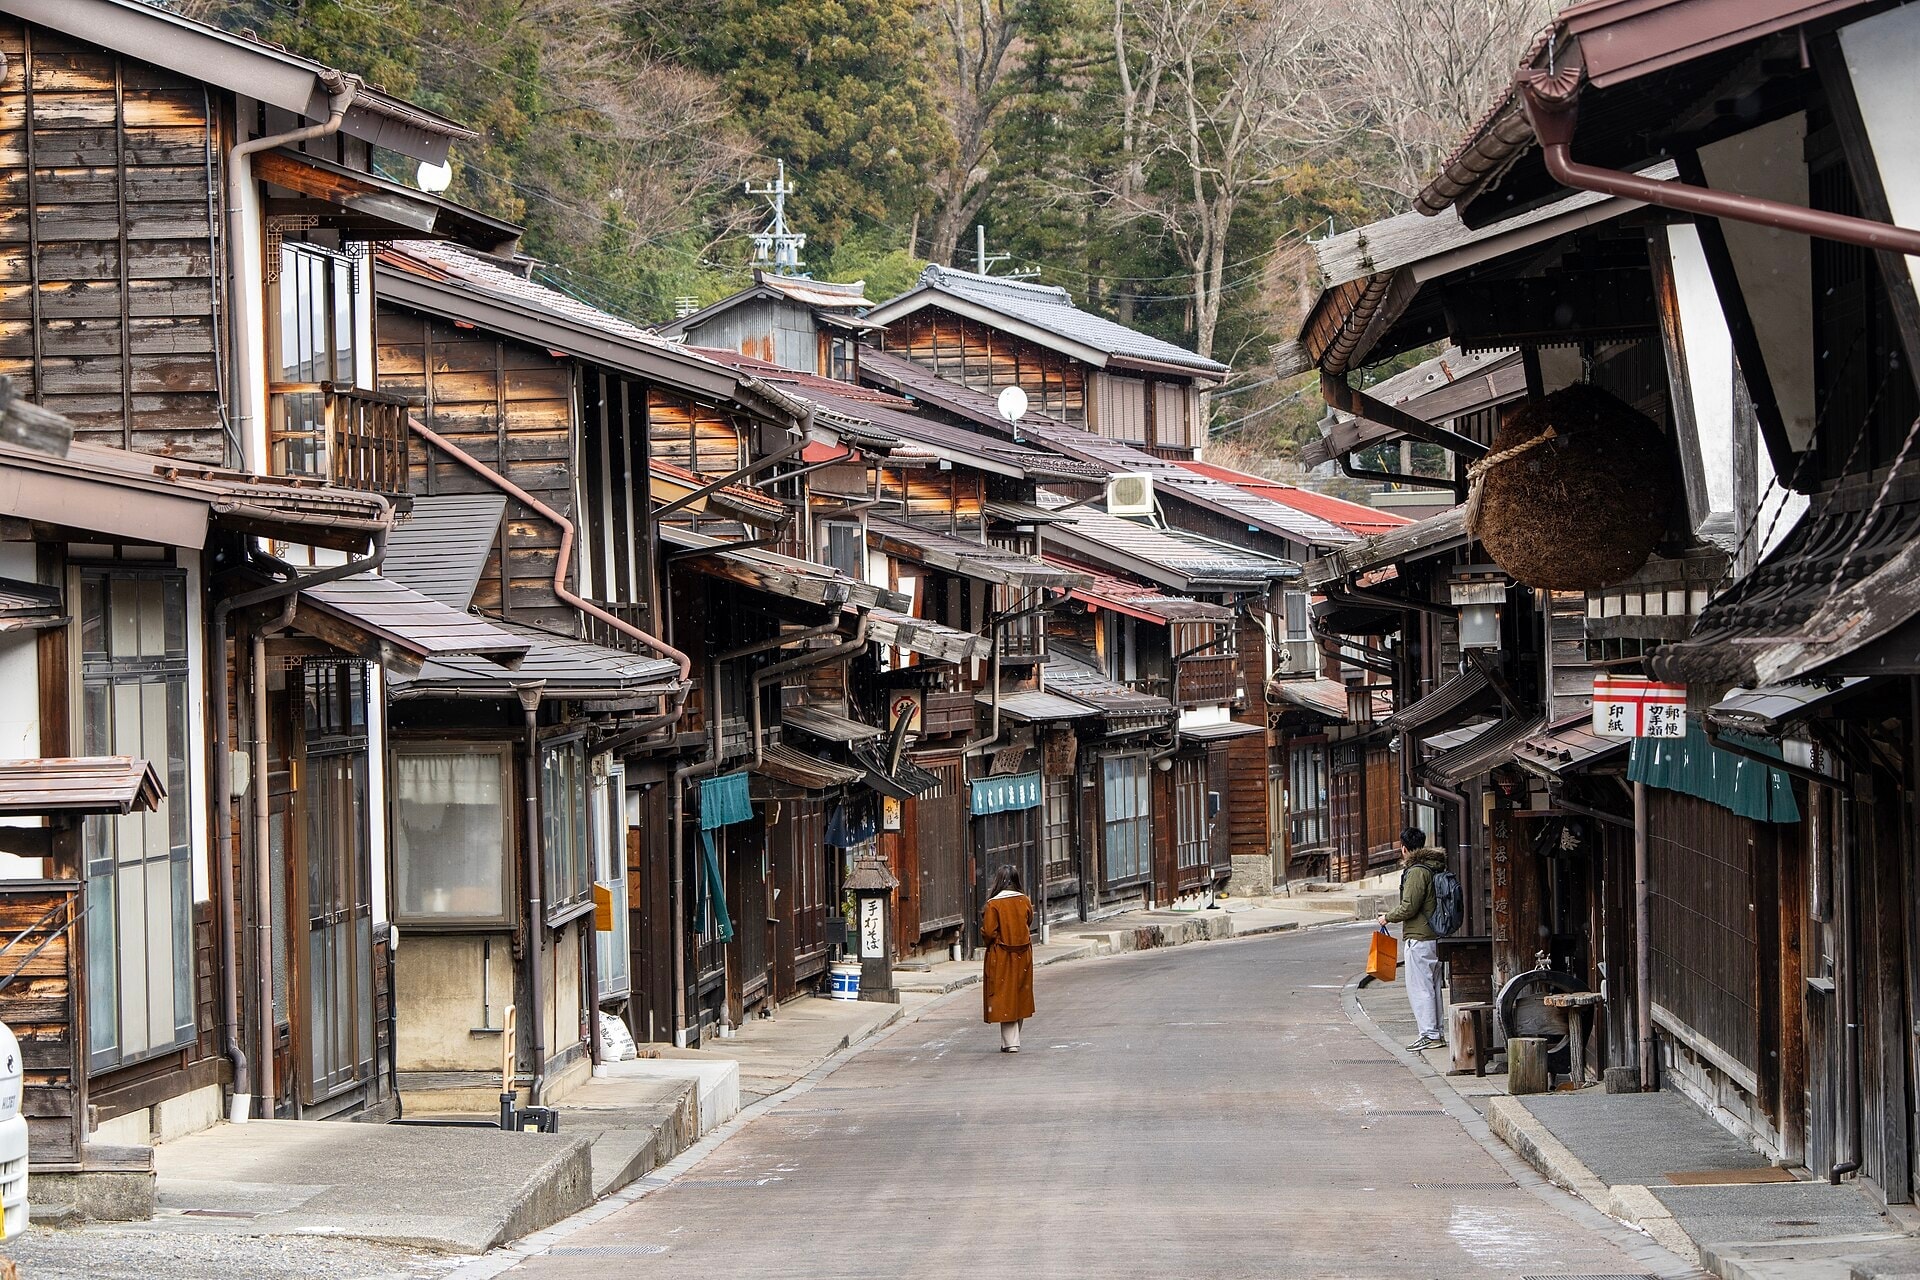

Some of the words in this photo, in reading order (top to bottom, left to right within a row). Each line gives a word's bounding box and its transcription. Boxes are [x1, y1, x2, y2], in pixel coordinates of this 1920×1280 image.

[1608, 704, 1624, 733] 印紙
[1647, 705, 1664, 737] 切手類
[1665, 705, 1680, 736] 郵便
[864, 900, 881, 951] 手打そば
